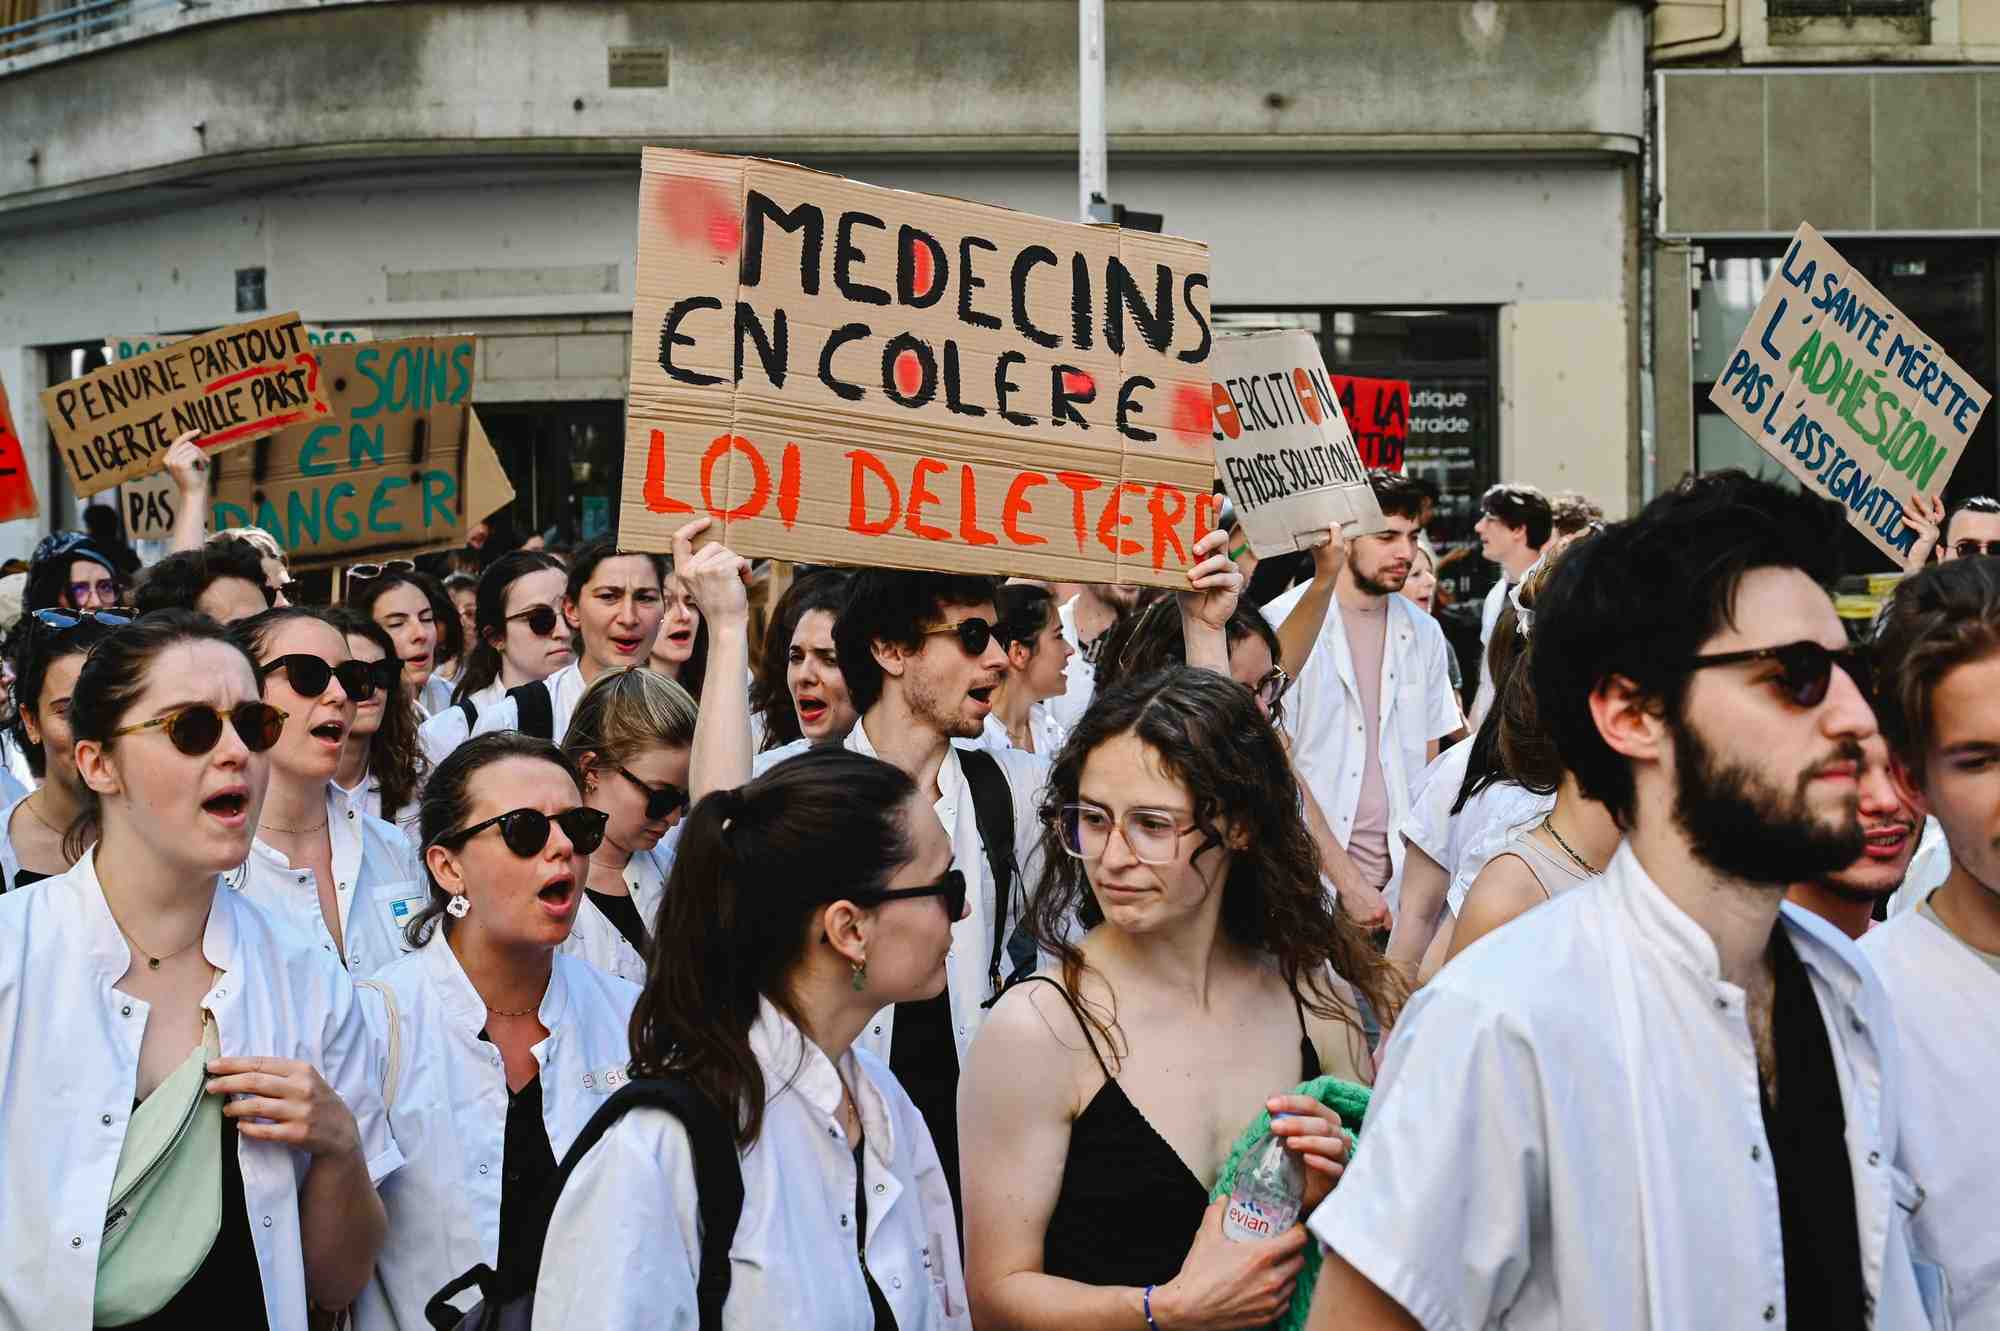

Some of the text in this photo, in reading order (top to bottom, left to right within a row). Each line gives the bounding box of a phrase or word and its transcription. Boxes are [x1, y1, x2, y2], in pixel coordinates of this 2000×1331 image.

[740, 190, 1212, 364] MEDECINS
[659, 296, 1157, 442] EN COLERE
[1782, 240, 1981, 434] LA SANTÉ MÉRITE
[55, 320, 303, 431] PENURIE PARTOUT
[352, 342, 473, 418] SOINS
[1212, 367, 1338, 441] OERCITION
[1374, 386, 1406, 428] LA
[1409, 389, 1467, 410] utique
[1721, 349, 1774, 415] PAS
[67, 413, 172, 481] LIBERTE
[171, 387, 247, 436] NULLE
[299, 424, 384, 477] EN
[1408, 414, 1469, 433] ntraide
[128, 489, 175, 533] PAS
[643, 429, 801, 531] LOI
[1225, 451, 1291, 513] FAUSSE
[1229, 1207, 1270, 1233] evian
